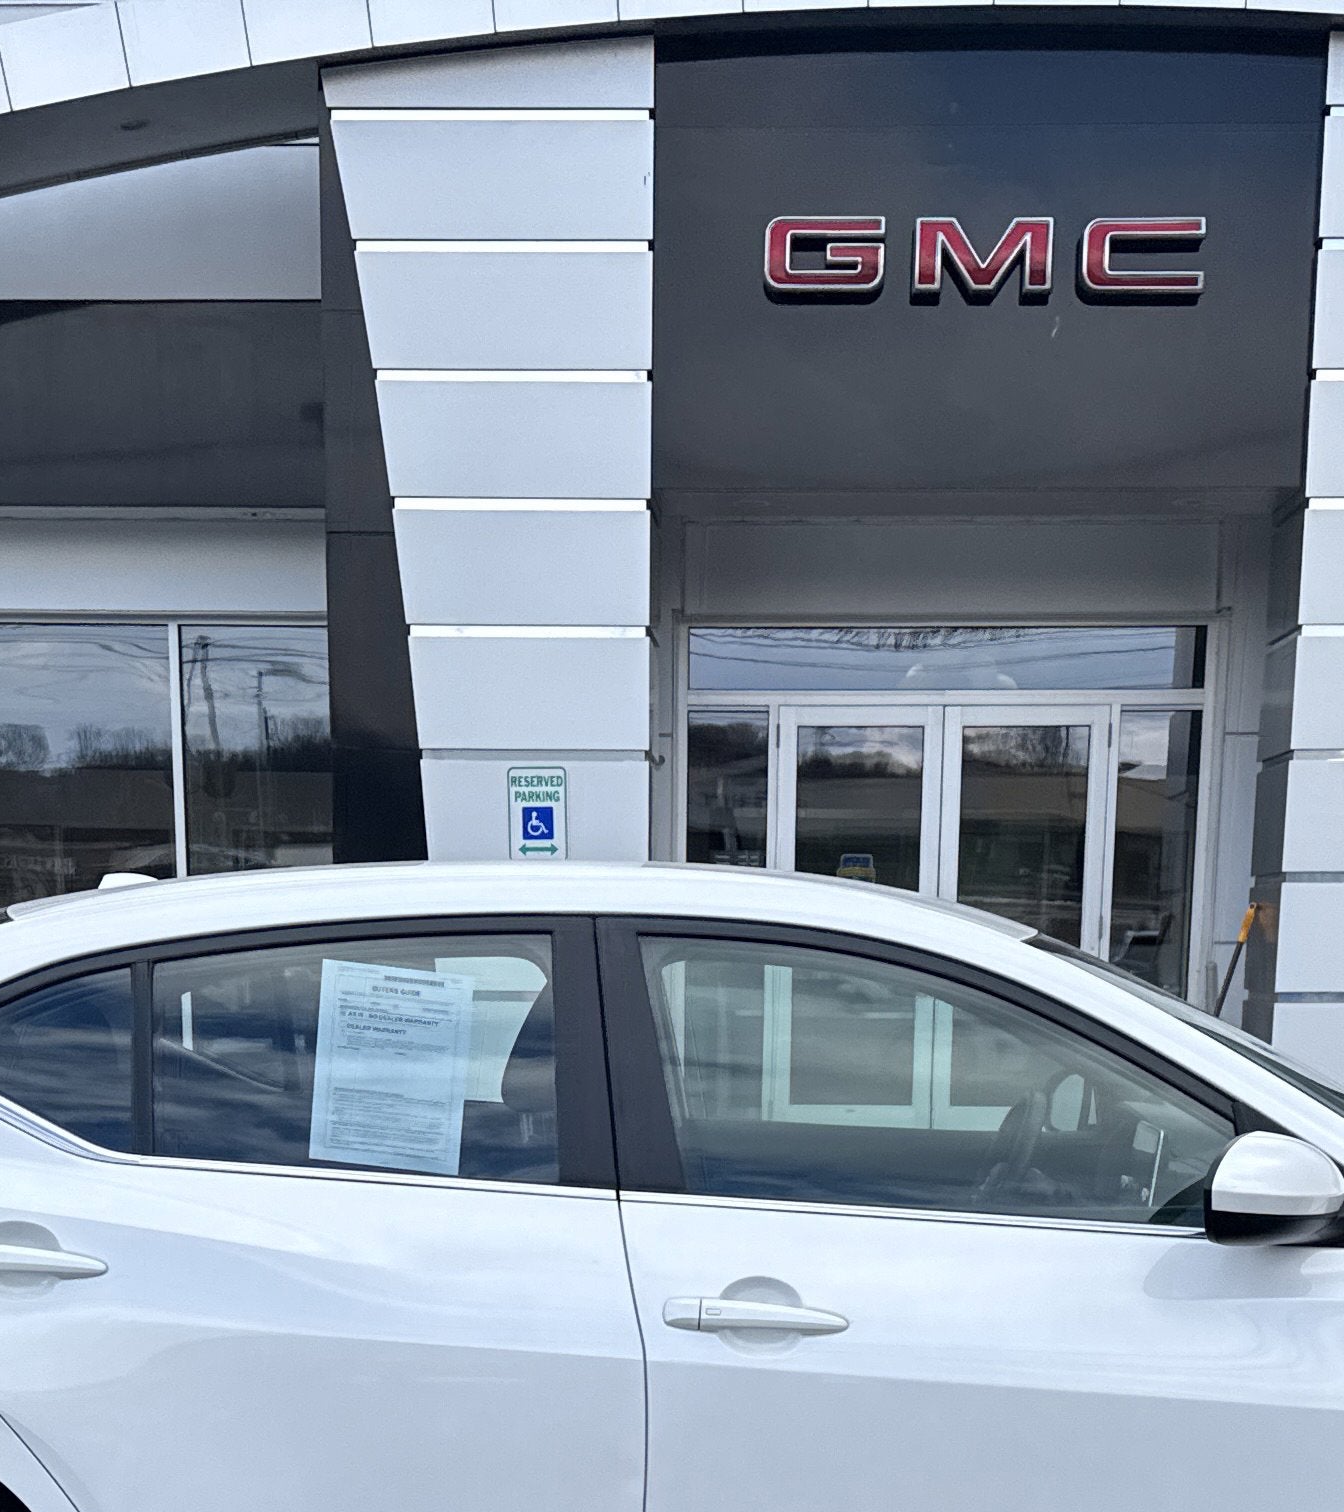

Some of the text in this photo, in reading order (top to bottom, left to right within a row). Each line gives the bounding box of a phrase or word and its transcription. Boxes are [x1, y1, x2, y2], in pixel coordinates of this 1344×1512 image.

[764, 215, 1207, 296] GMC
[510, 775, 563, 787] RESERVED
[514, 790, 560, 802] PARKING
